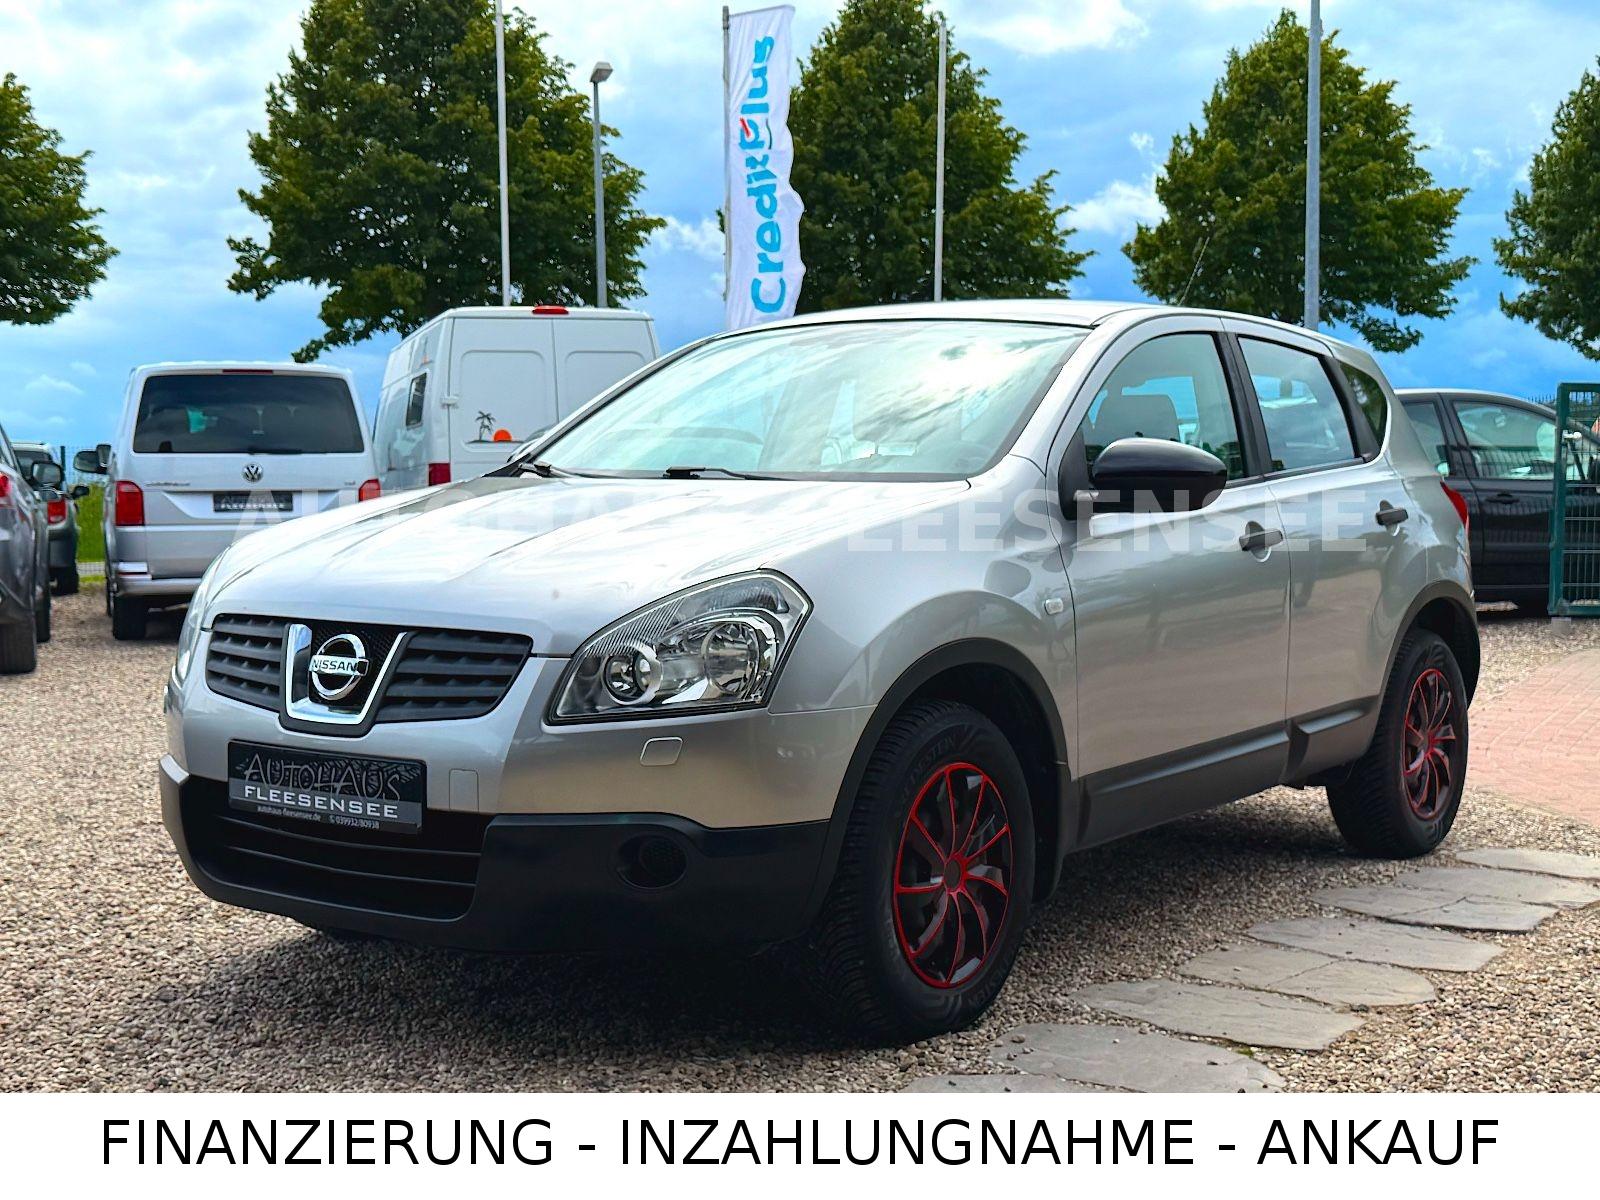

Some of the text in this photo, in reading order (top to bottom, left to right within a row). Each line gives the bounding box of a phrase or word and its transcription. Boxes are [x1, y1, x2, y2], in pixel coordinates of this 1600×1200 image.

[309, 659, 359, 673] NISSAN
[244, 753, 402, 801] AUTOHAUS
[244, 785, 398, 819] FLEESENSEE
